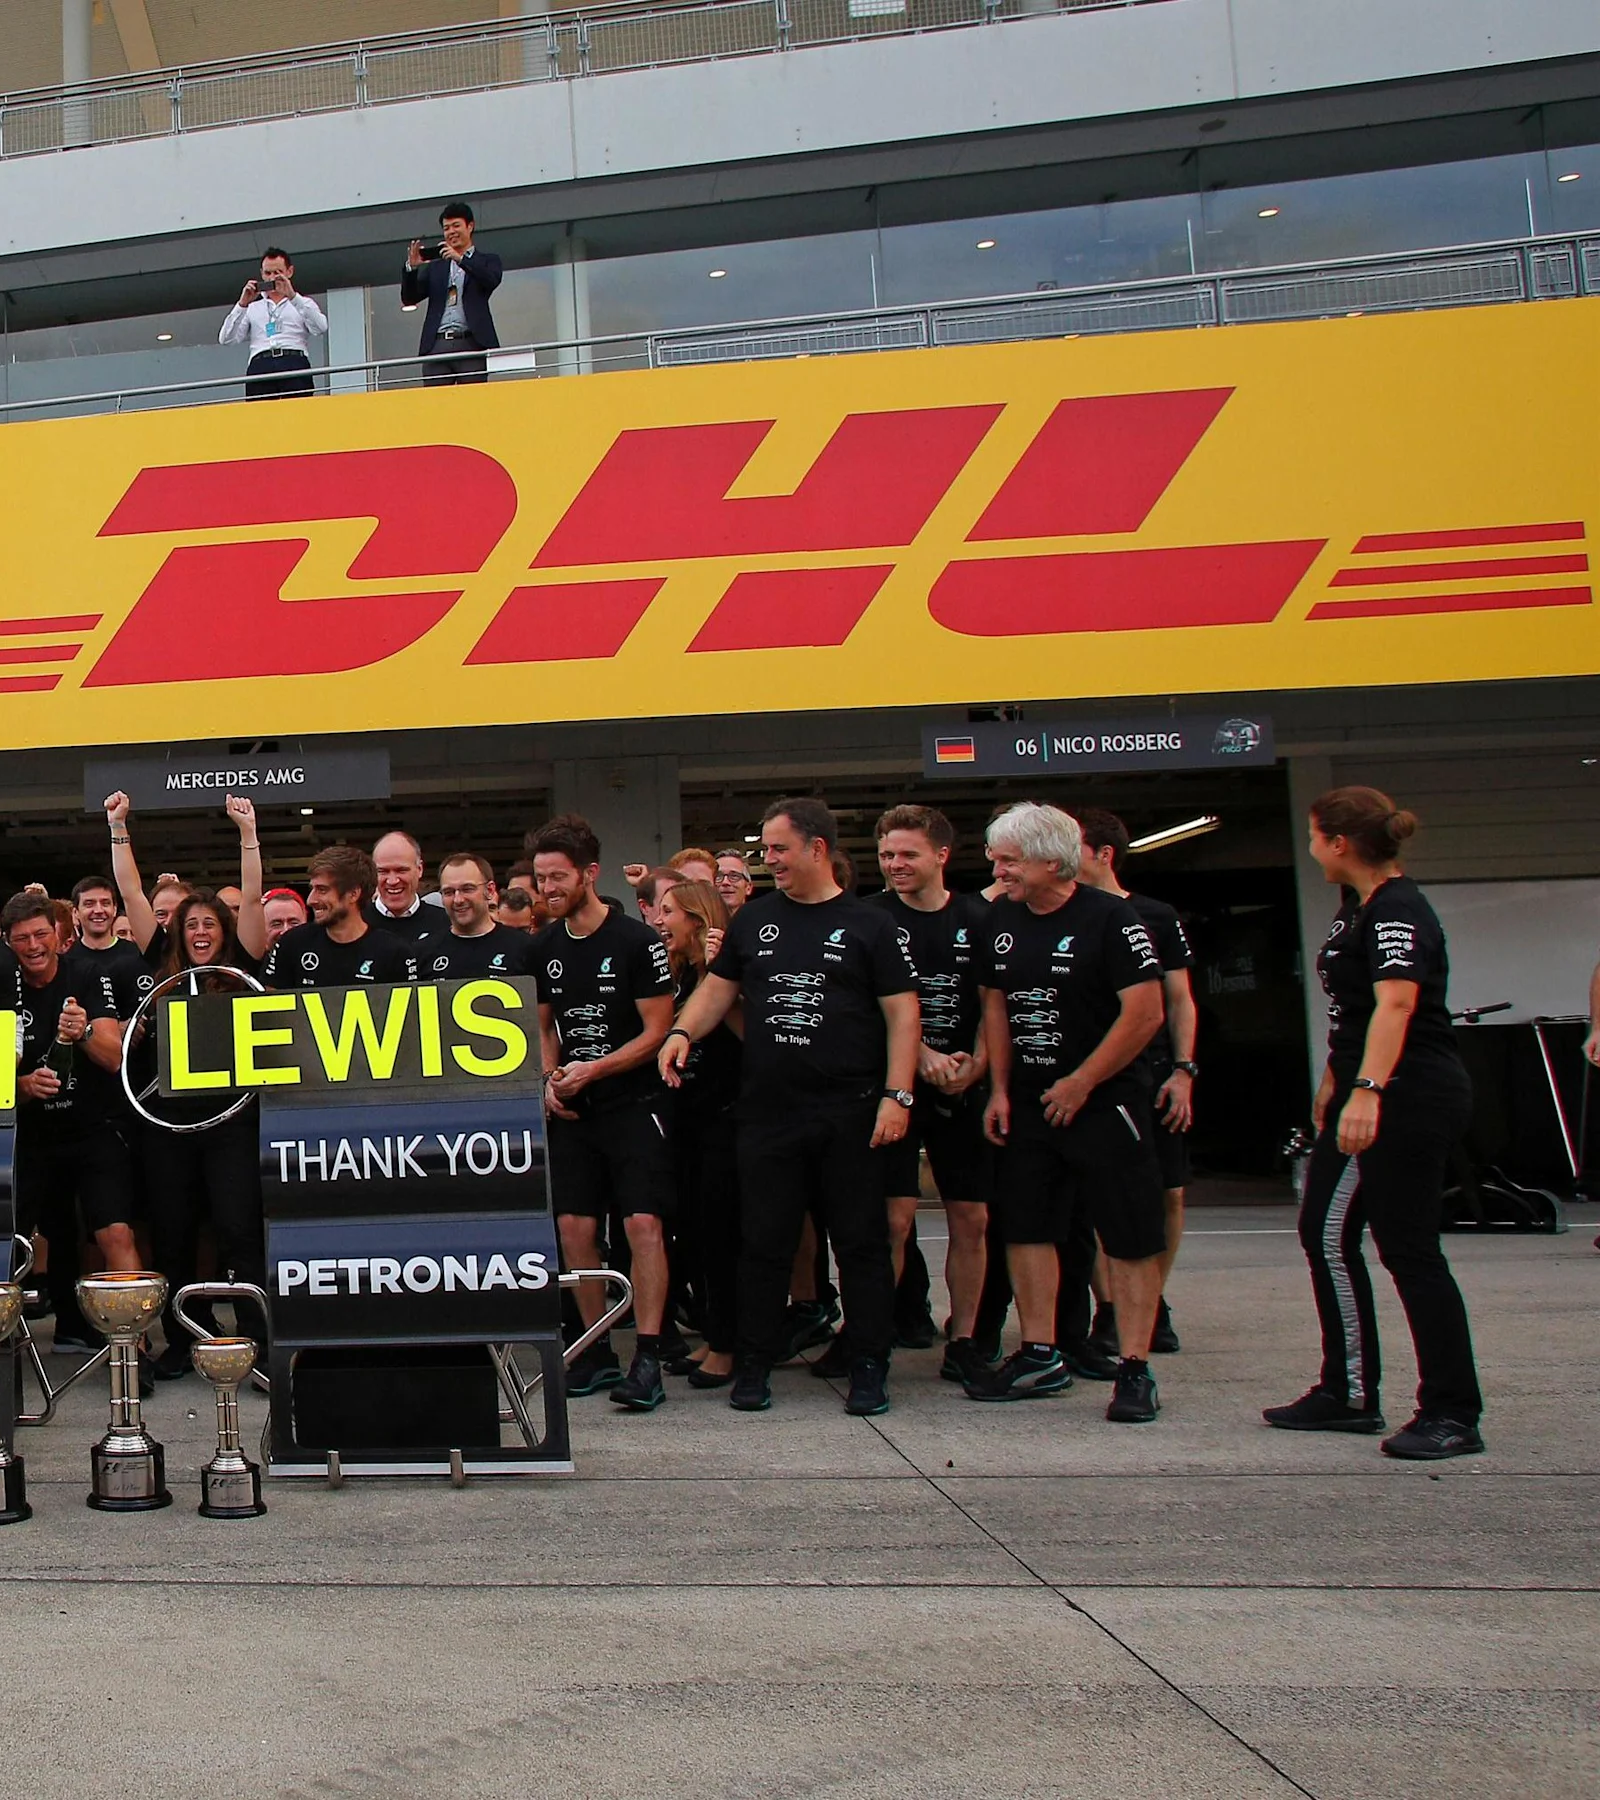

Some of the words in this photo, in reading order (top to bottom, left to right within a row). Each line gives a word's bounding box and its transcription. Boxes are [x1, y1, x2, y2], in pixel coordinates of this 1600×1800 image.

[83, 386, 1330, 687] DHL
[1015, 739, 1037, 756] 06
[1053, 737, 1096, 755] NICO
[1101, 733, 1182, 752] ROSBERG
[166, 770, 259, 789] MERCEDES
[264, 767, 305, 785] AMG
[1377, 930, 1413, 941] EPSON
[167, 979, 528, 1091] LEWIS
[774, 1033, 788, 1043] The
[789, 1034, 811, 1046] Triple
[1022, 1054, 1035, 1064] The
[1036, 1055, 1057, 1066] Triple
[270, 1133, 428, 1183] THANK
[436, 1130, 533, 1177] YOU
[277, 1253, 549, 1297] PETRONAS
